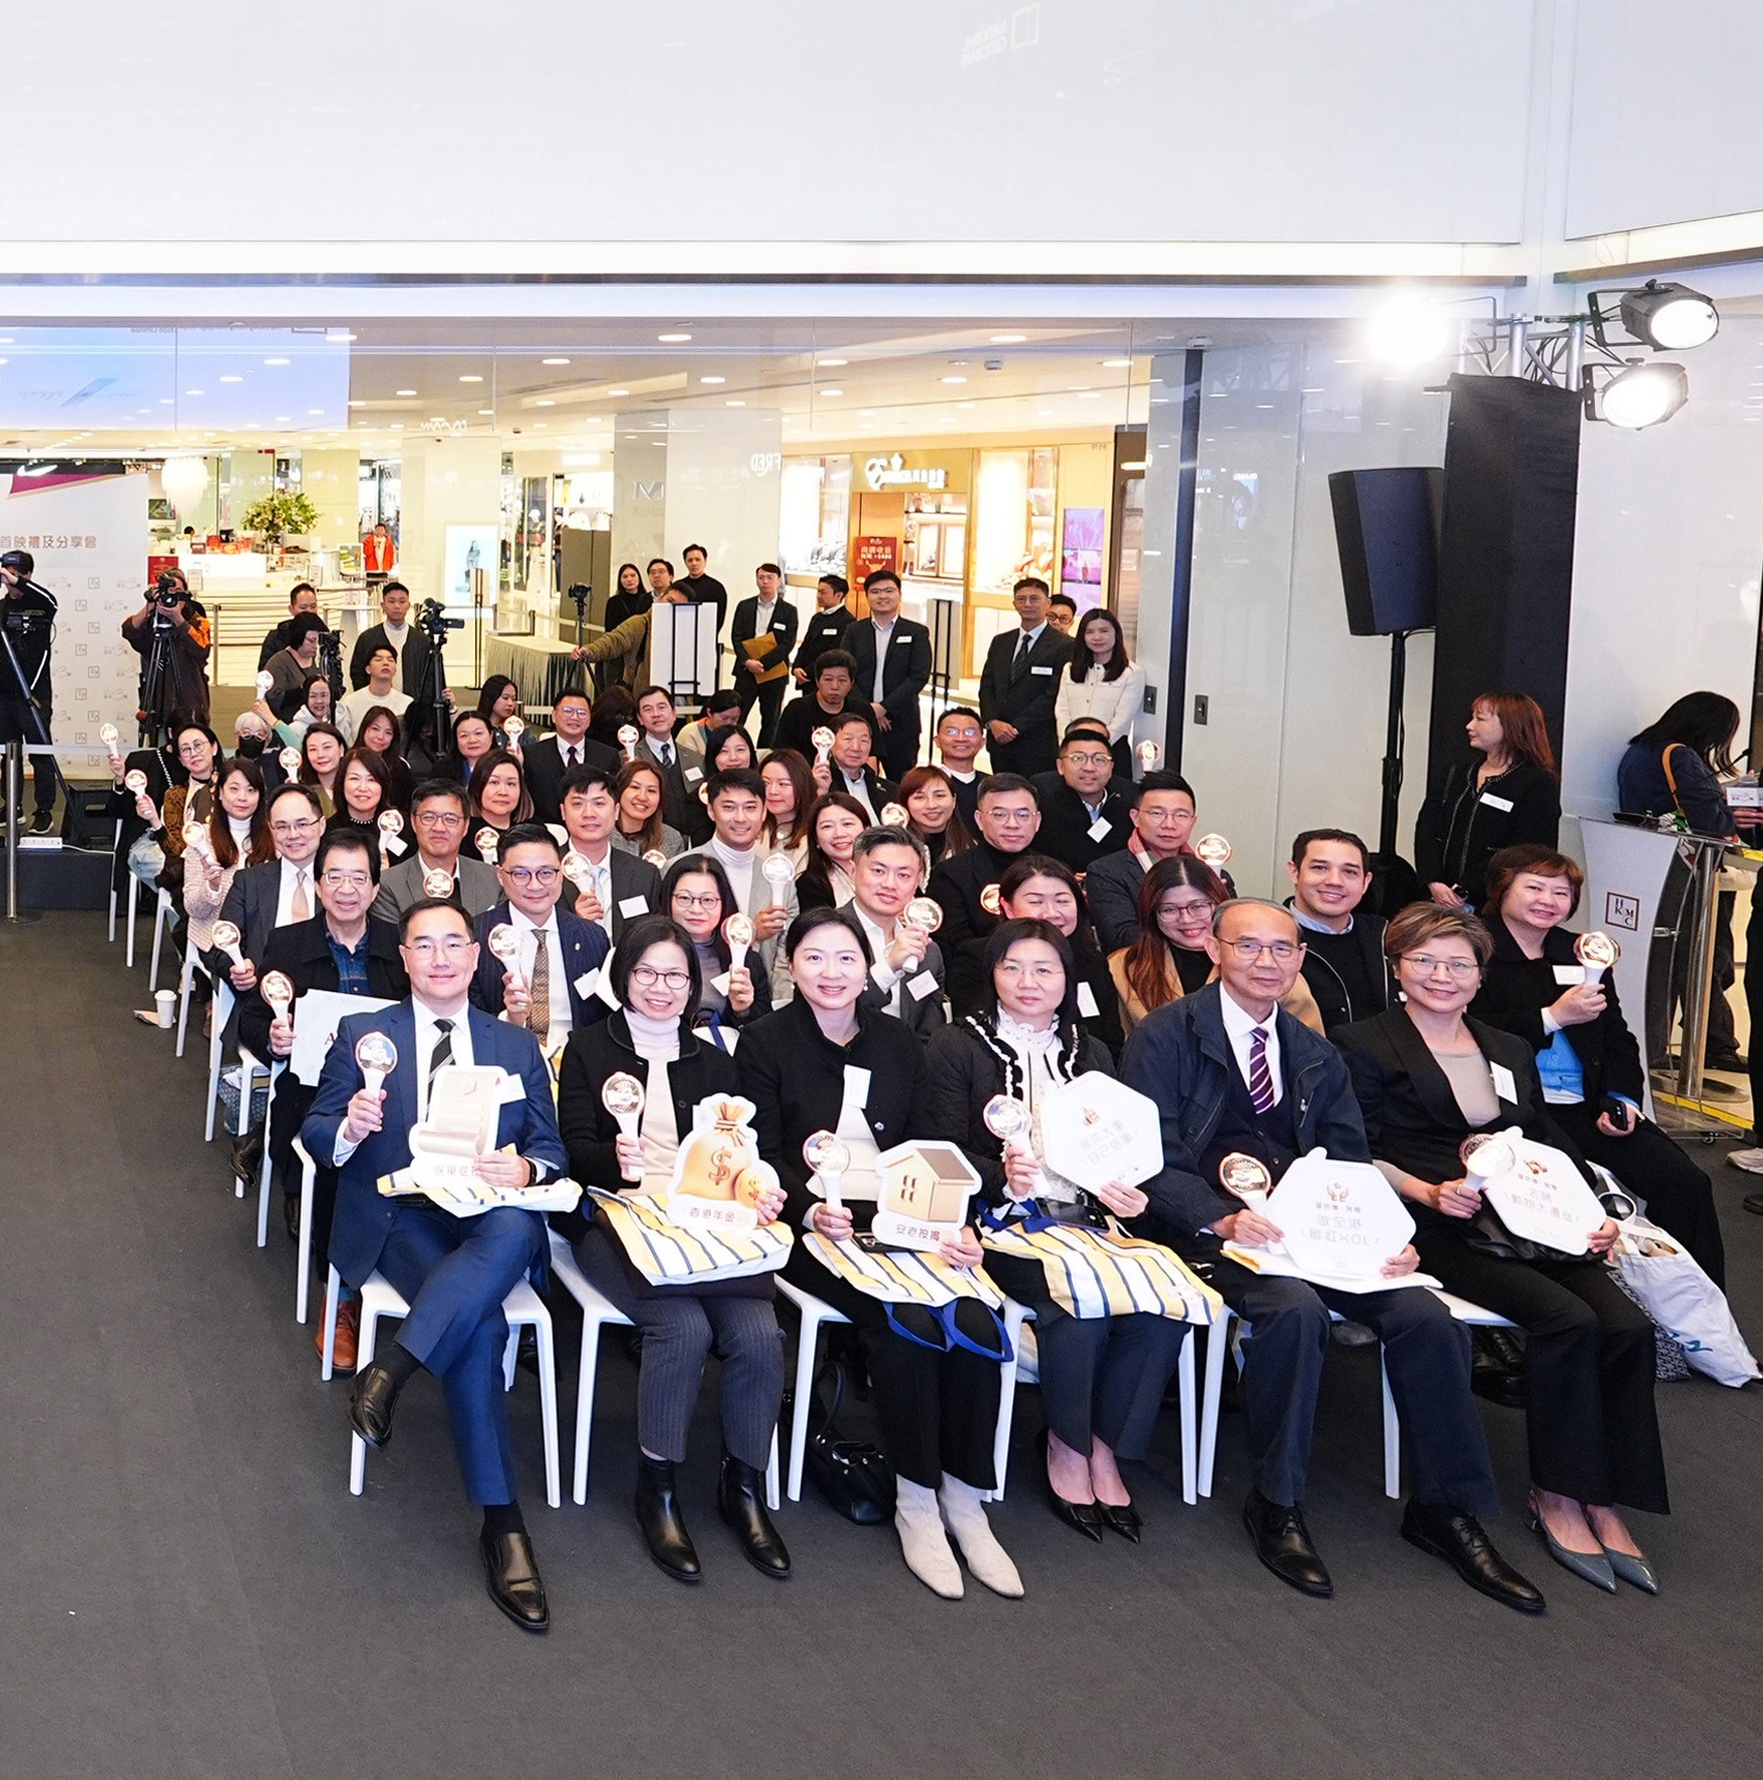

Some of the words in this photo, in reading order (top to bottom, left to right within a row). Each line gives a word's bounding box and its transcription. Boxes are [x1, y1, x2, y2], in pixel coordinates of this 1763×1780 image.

[689, 1206, 735, 1223] 香港年金
[895, 1223, 941, 1242] 安老按揭
